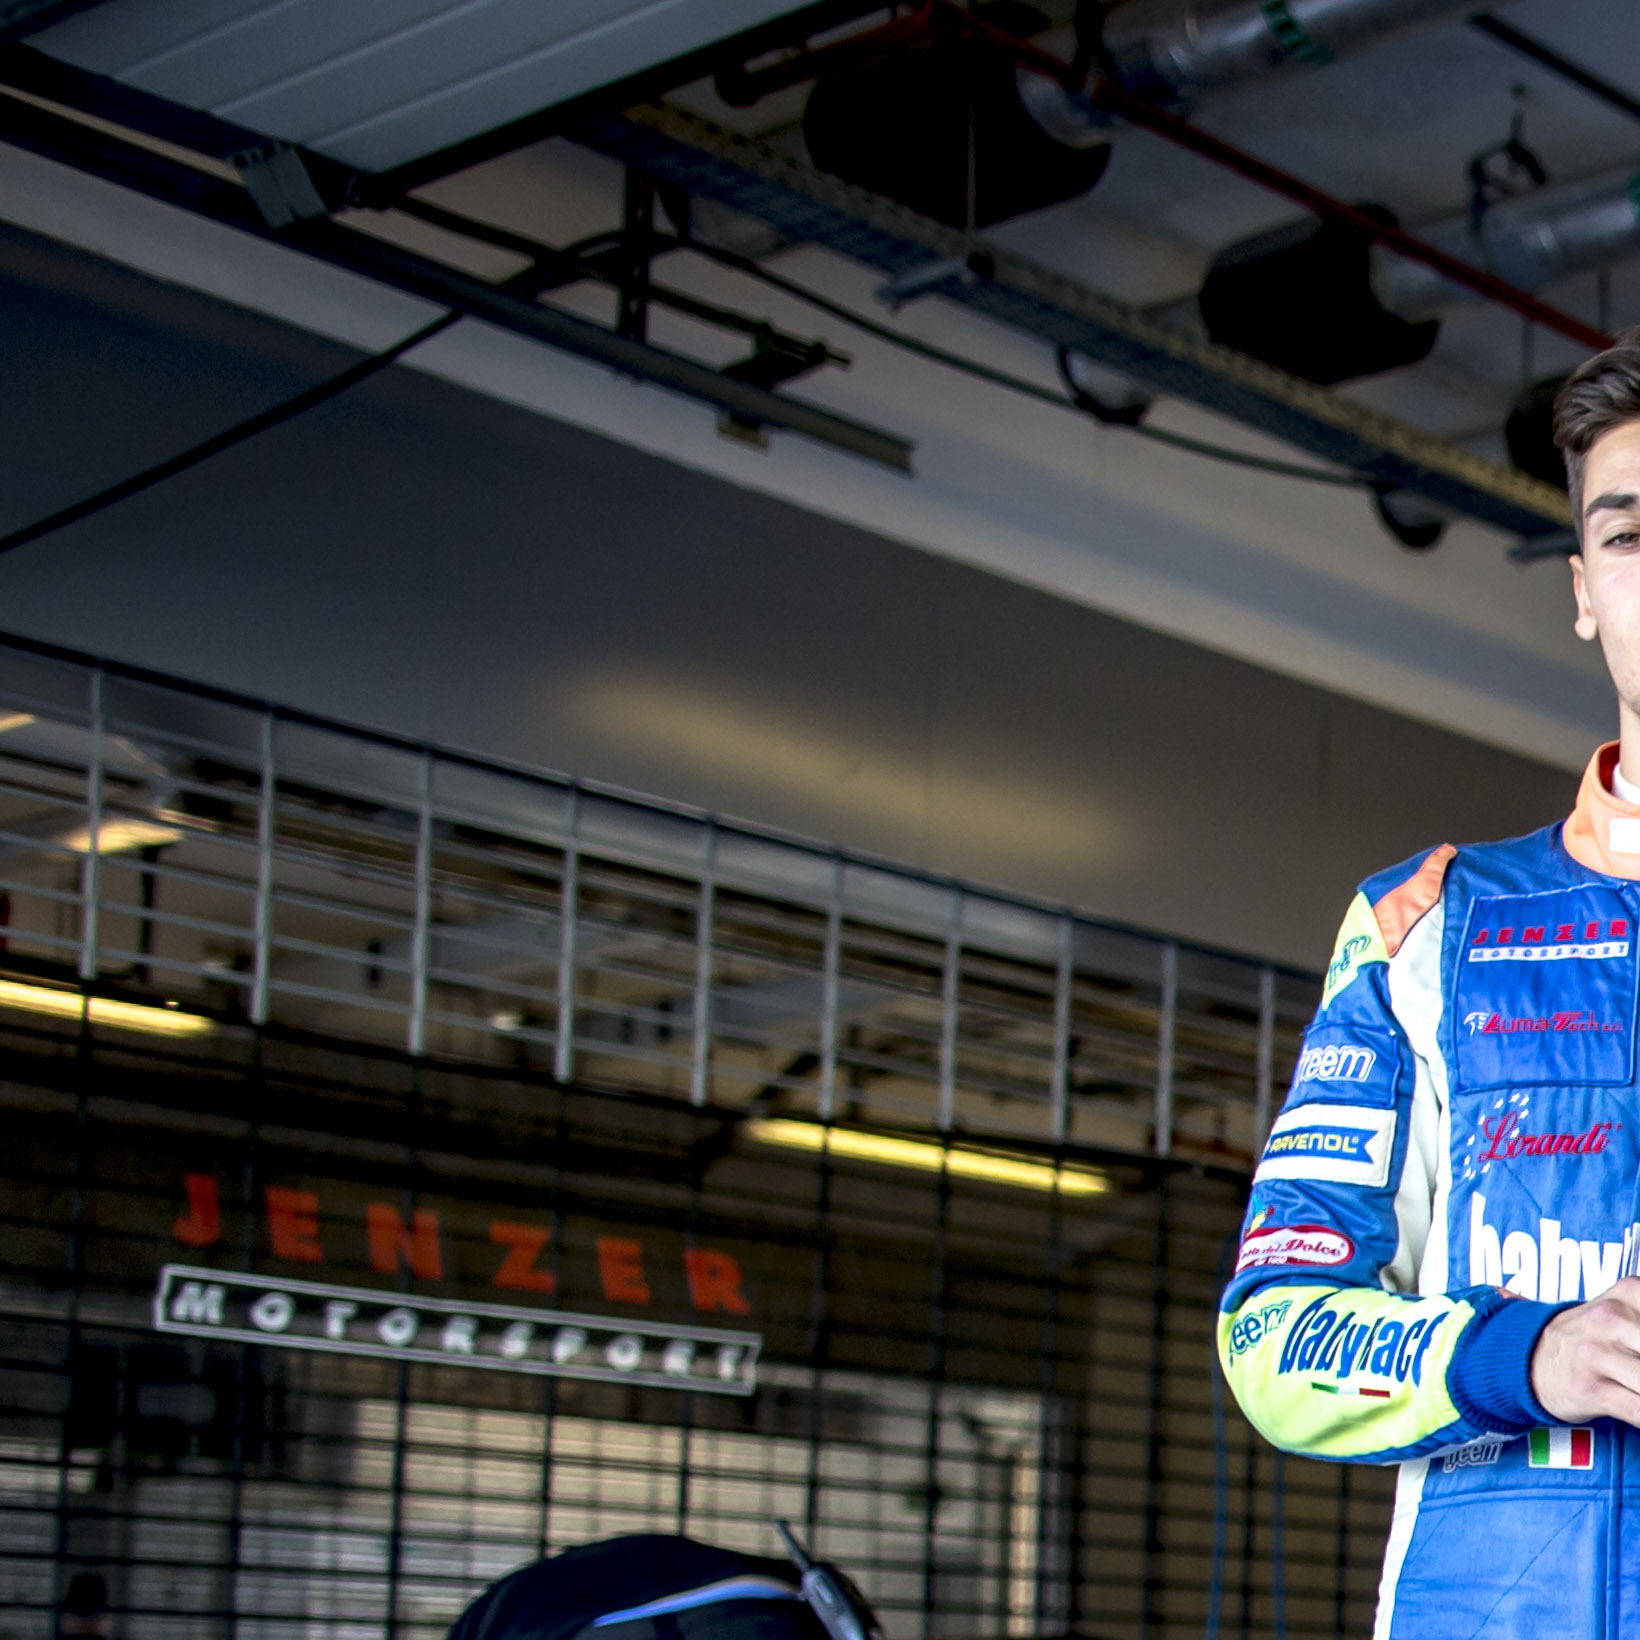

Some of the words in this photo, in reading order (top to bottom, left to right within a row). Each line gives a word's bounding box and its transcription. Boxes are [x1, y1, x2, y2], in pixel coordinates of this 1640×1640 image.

[1472, 919, 1628, 945] JENZER
[1472, 945, 1626, 960] MOTORSPORT
[172, 1173, 751, 1315] JENZER
[173, 1281, 740, 1382] MOTORSPORT
